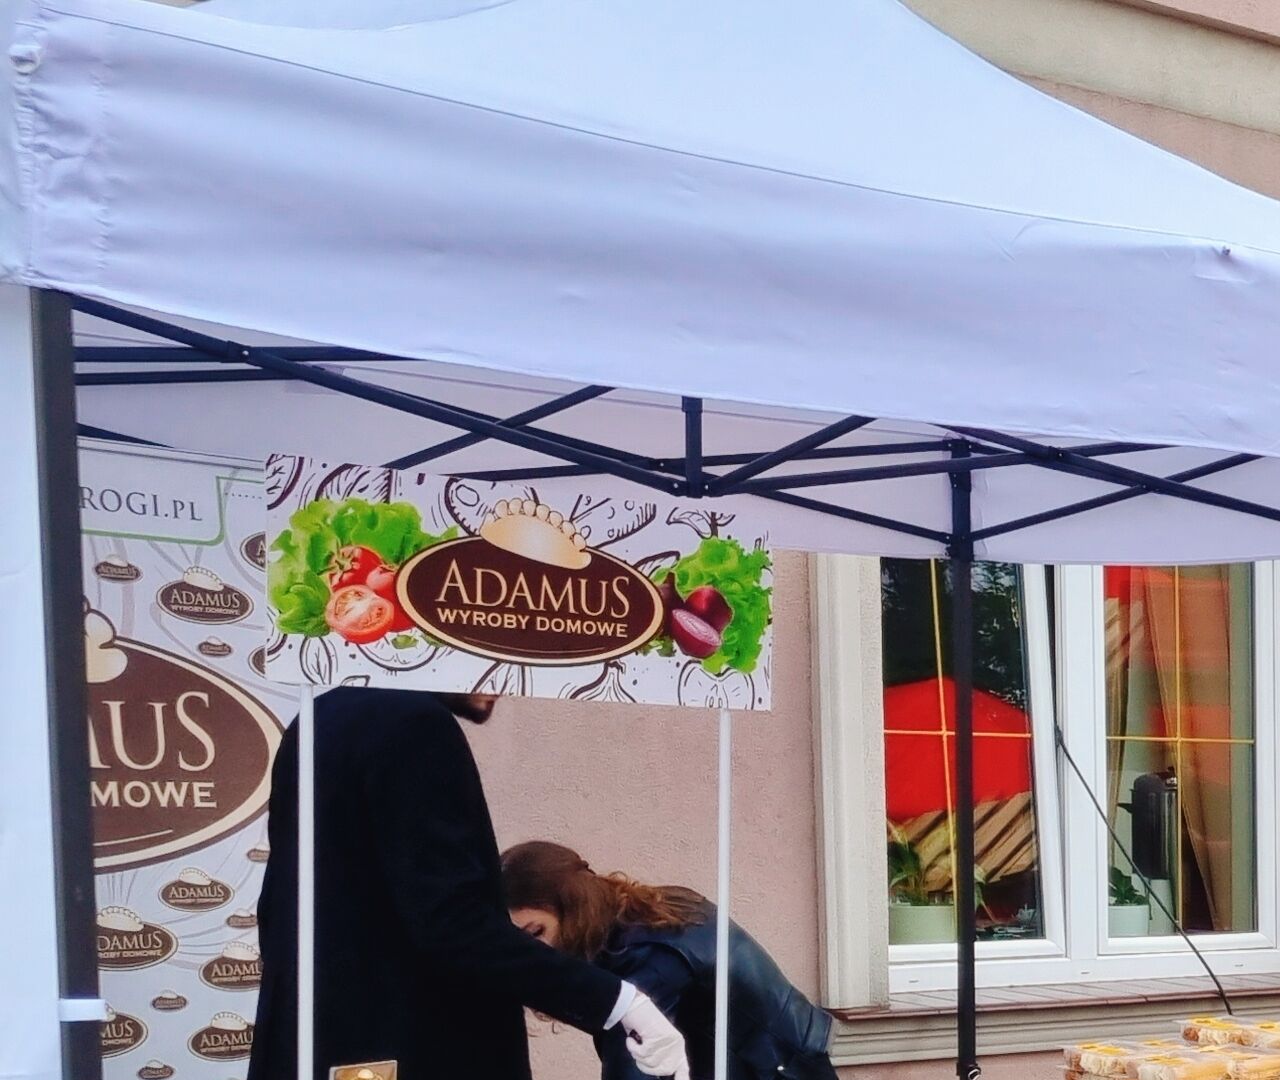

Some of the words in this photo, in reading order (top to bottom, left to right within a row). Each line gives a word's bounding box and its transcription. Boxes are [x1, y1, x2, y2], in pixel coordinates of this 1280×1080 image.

[79, 486, 203, 522] ROGI.PL
[171, 588, 240, 608] ADAMUS
[435, 558, 631, 619] ADAMUS
[437, 607, 530, 629] WYROBY
[536, 617, 628, 638] DOMOWE
[91, 780, 217, 808] MOWE
[169, 885, 225, 899] ADAMUS
[97, 930, 163, 951] DAMUS
[200, 1031, 254, 1048] ADAMU
